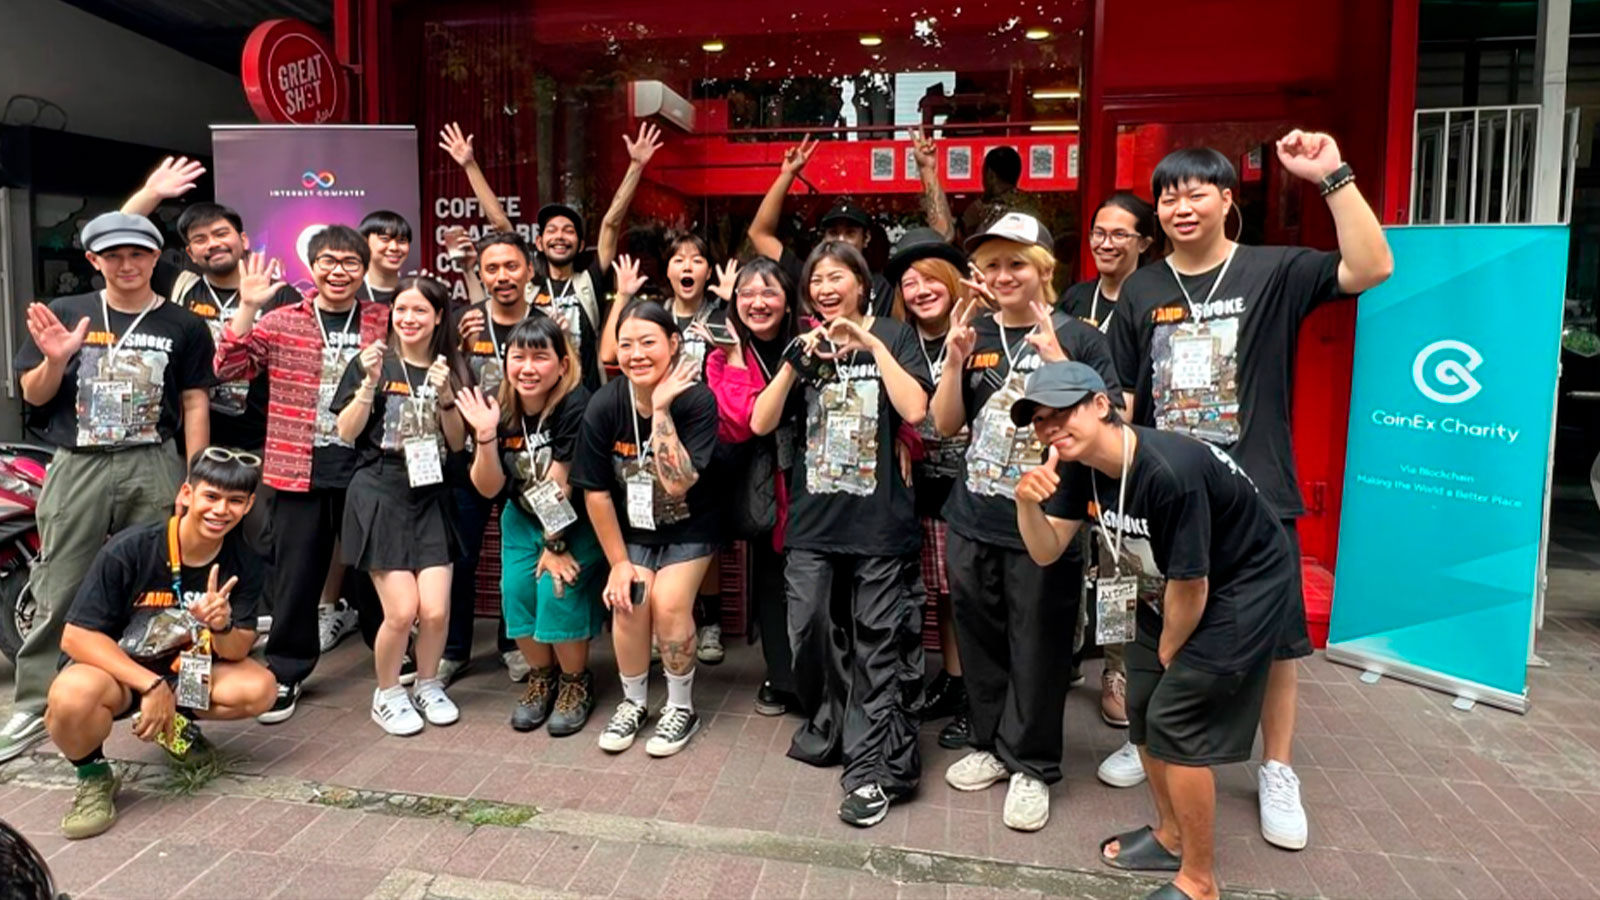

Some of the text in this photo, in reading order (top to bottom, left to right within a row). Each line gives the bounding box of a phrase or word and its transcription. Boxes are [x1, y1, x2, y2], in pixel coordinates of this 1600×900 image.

[278, 54, 322, 91] GREAT
[1191, 297, 1246, 319] SMOKE
[124, 333, 174, 352] SMOKE
[839, 364, 881, 380] SMOK
[1371, 409, 1520, 445] CoinEx Charity
[1399, 463, 1474, 483] Via Blockchain
[1356, 474, 1523, 508] Making the World a Better Place
[1104, 508, 1151, 538] SMOKE
